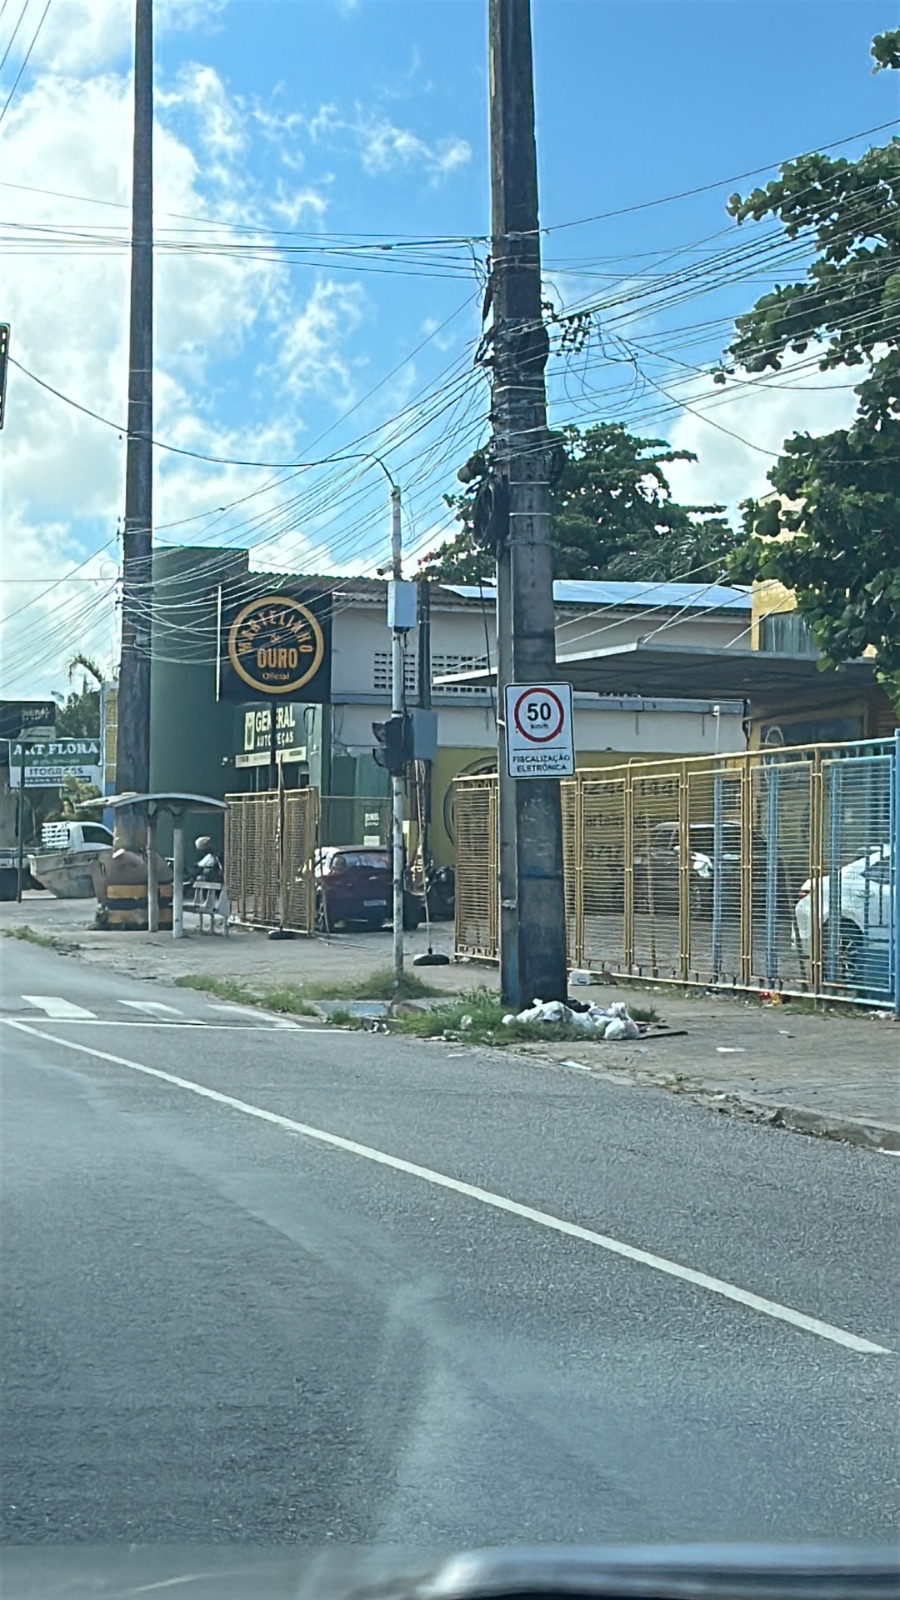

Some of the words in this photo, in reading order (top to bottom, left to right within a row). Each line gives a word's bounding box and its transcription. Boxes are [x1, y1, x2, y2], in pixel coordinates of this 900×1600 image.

[257, 648, 298, 668] OURO
[527, 702, 551, 721] 50
[256, 731, 294, 747] AUTOEÇAS
[48, 742, 99, 754] FLORA
[513, 754, 570, 763] FISCALIZAÇÃO
[517, 763, 566, 772] ELETRÔNICA
